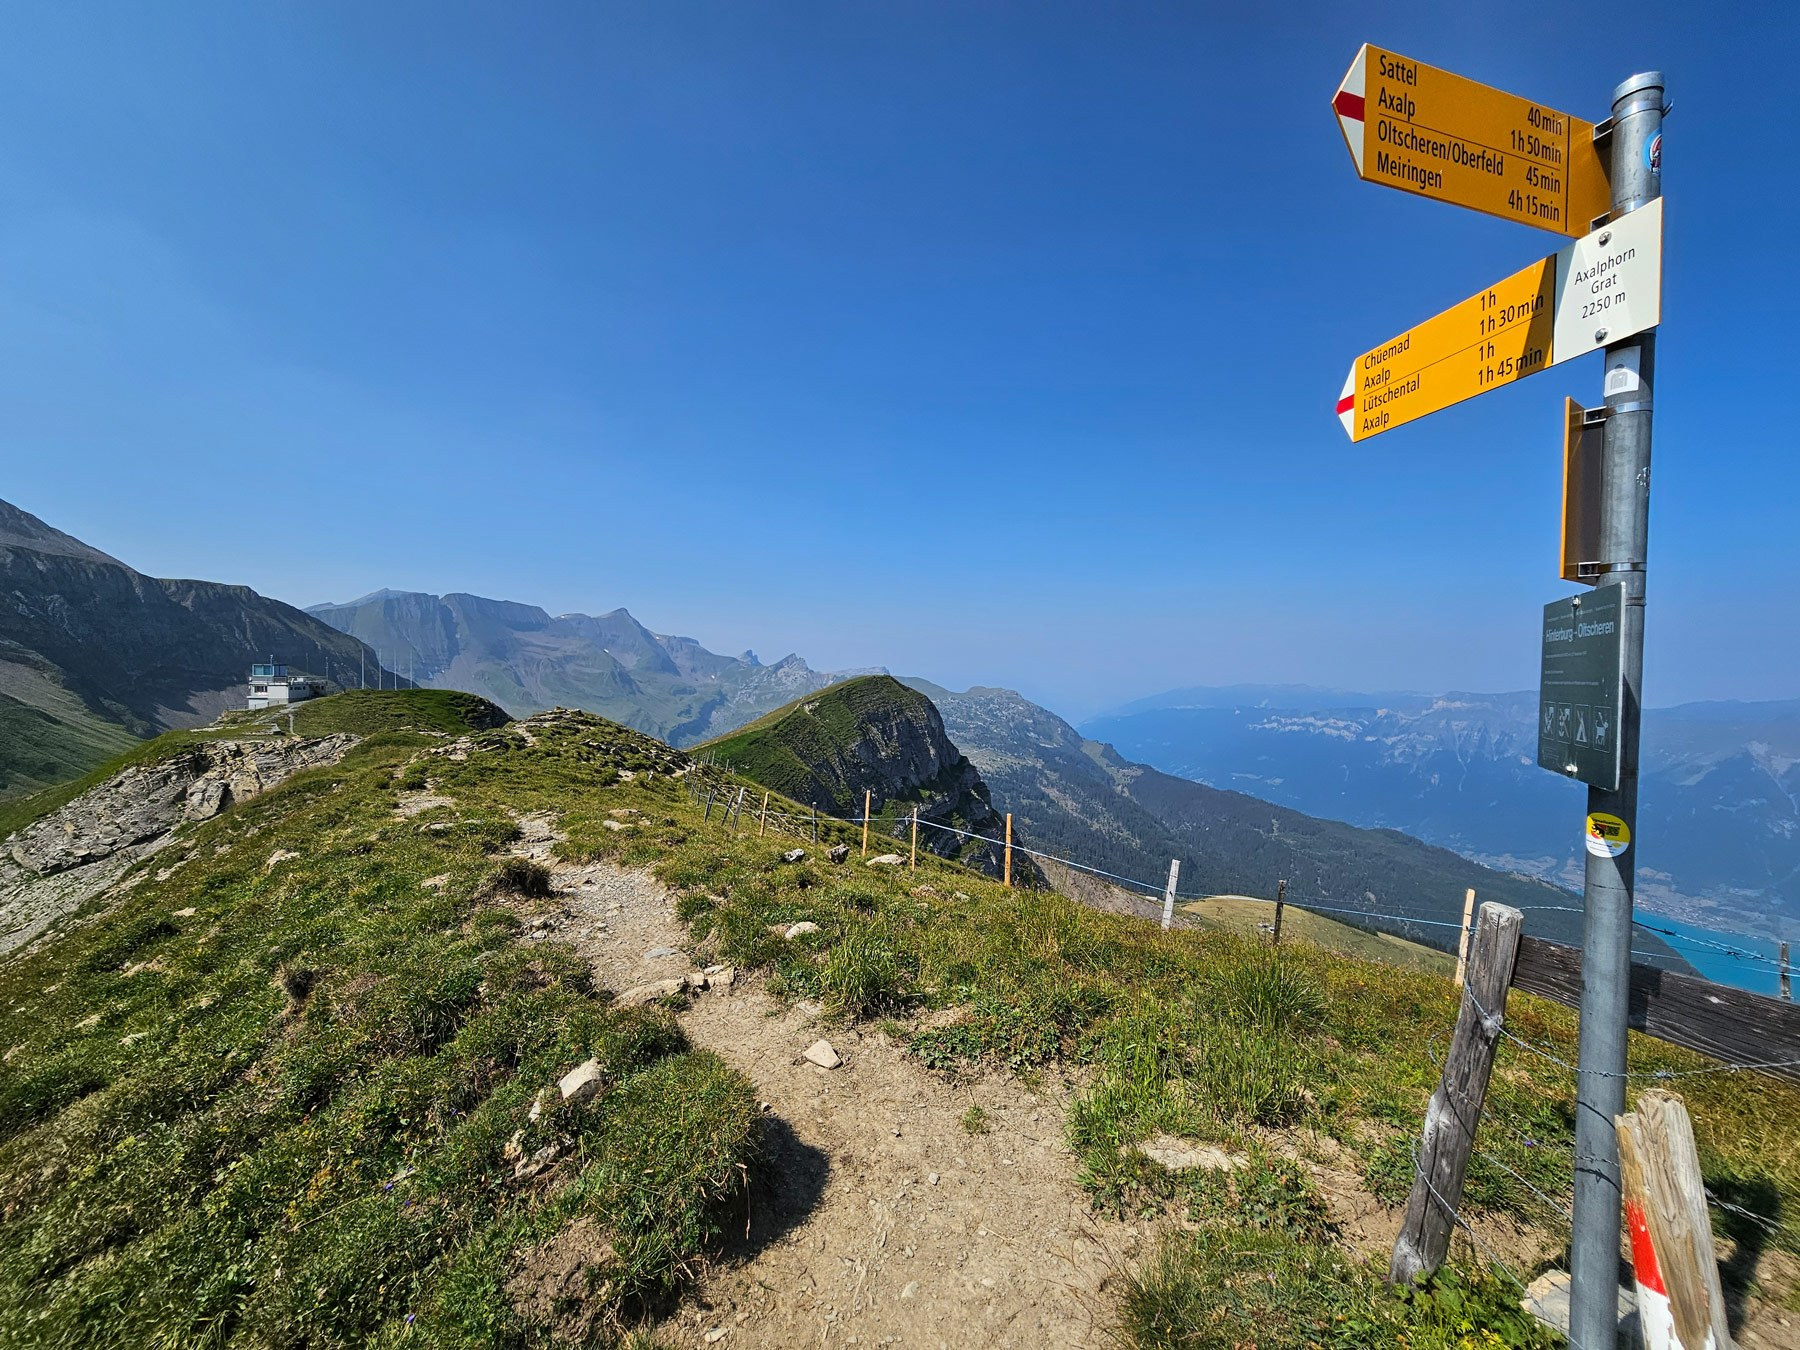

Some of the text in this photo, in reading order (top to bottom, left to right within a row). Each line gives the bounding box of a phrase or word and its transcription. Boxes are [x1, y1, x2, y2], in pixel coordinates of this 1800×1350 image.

[1379, 54, 1417, 87] Sattel
[1378, 86, 1416, 122] Axalp
[1378, 119, 1504, 177] Oltscheren/Oberfeld
[1377, 150, 1442, 190] Meiringen
[1574, 248, 1636, 286] Axalphorn
[1591, 273, 1617, 295] Grat
[1582, 292, 1626, 319] 2250 m
[1364, 333, 1410, 370] Chüemad
[1363, 367, 1391, 392] Axalp
[1363, 373, 1420, 413] Lütschental
[1362, 410, 1390, 433] Axalp
